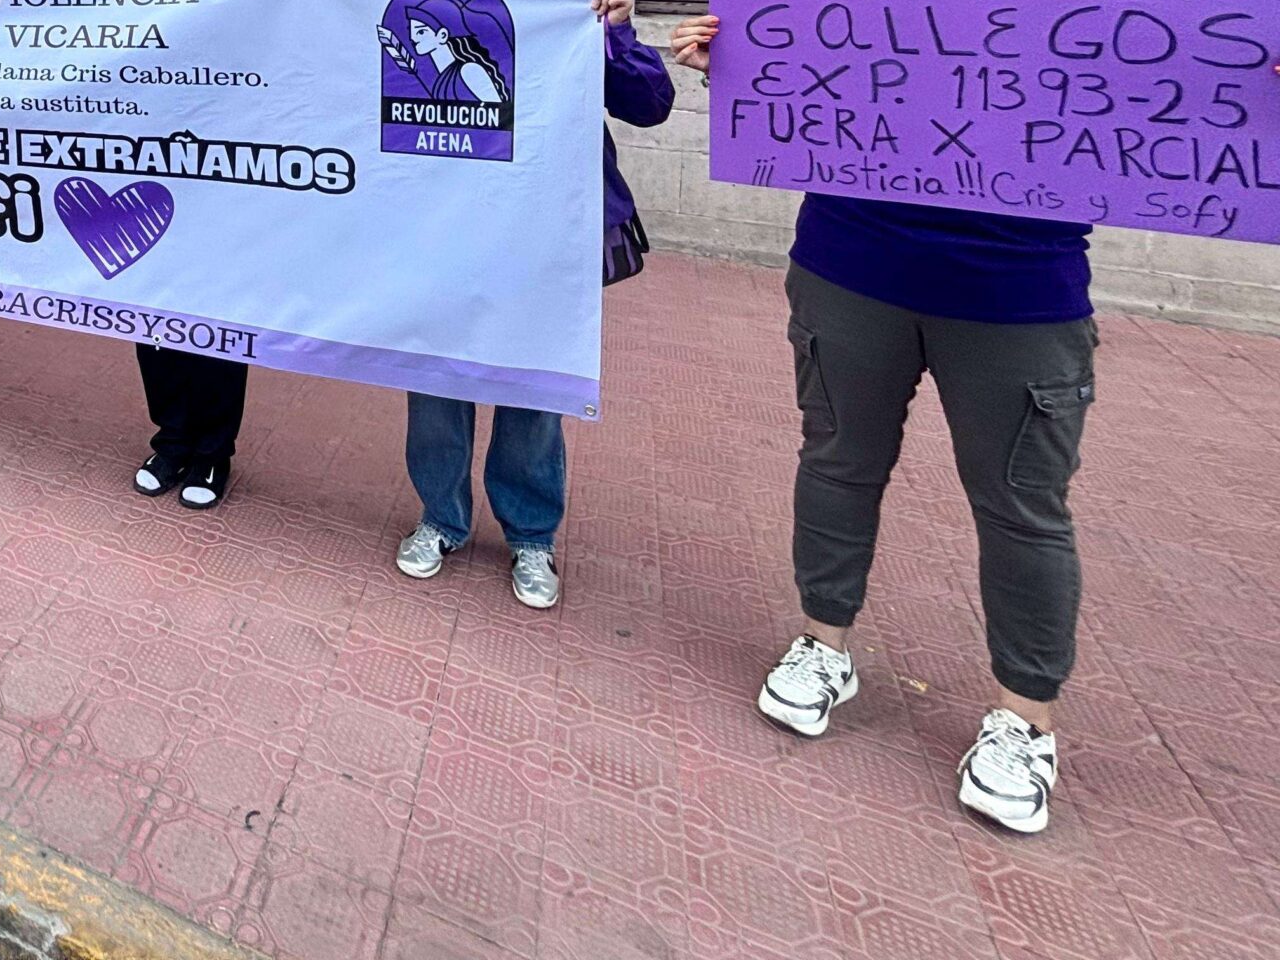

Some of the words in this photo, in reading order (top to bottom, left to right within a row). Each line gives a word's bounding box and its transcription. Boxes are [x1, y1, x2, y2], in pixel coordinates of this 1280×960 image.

[4, 23, 170, 50] VICARIA
[60, 63, 112, 84] Cris
[118, 64, 270, 88] Caballero.
[20, 94, 150, 117] sustituta.
[751, 58, 909, 104] EXP.
[952, 64, 1248, 129] 11393-25
[391, 101, 500, 127] REVOLUCIÓN
[415, 131, 473, 154] ATENA
[731, 98, 900, 154] FUERA
[930, 118, 977, 158] X
[1020, 120, 1280, 190] PARCIAL
[15, 128, 356, 195] EXTRAÑAMOS
[1089, 194, 1109, 223] y
[1135, 192, 1238, 237] Sofy
